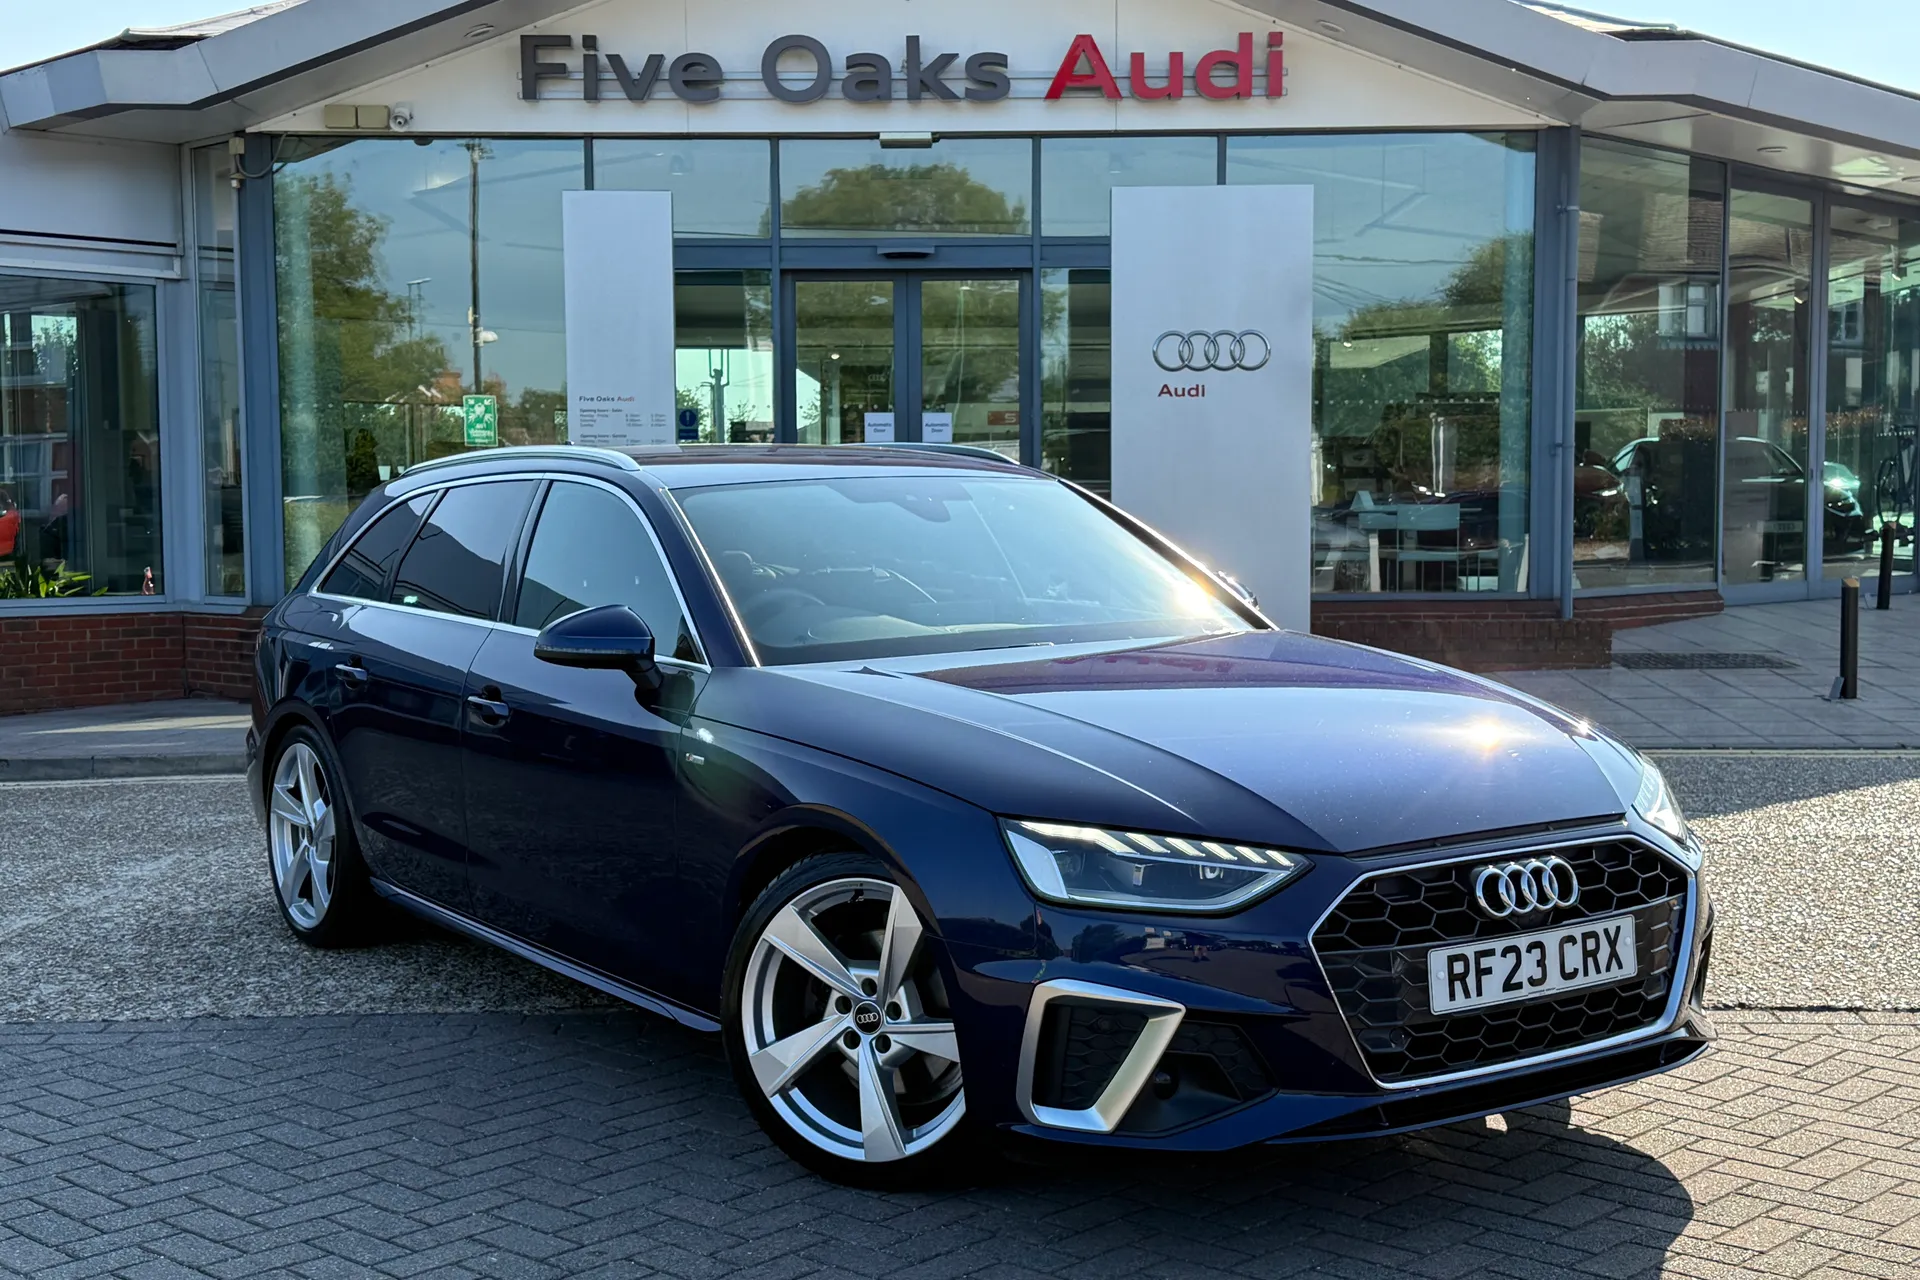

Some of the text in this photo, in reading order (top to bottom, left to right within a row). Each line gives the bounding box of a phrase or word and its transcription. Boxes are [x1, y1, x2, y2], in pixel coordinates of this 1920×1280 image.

[520, 31, 1284, 101] Five Oaks Audi
[1158, 383, 1206, 398] Audi
[1446, 924, 1624, 1003] RF23 CRX
